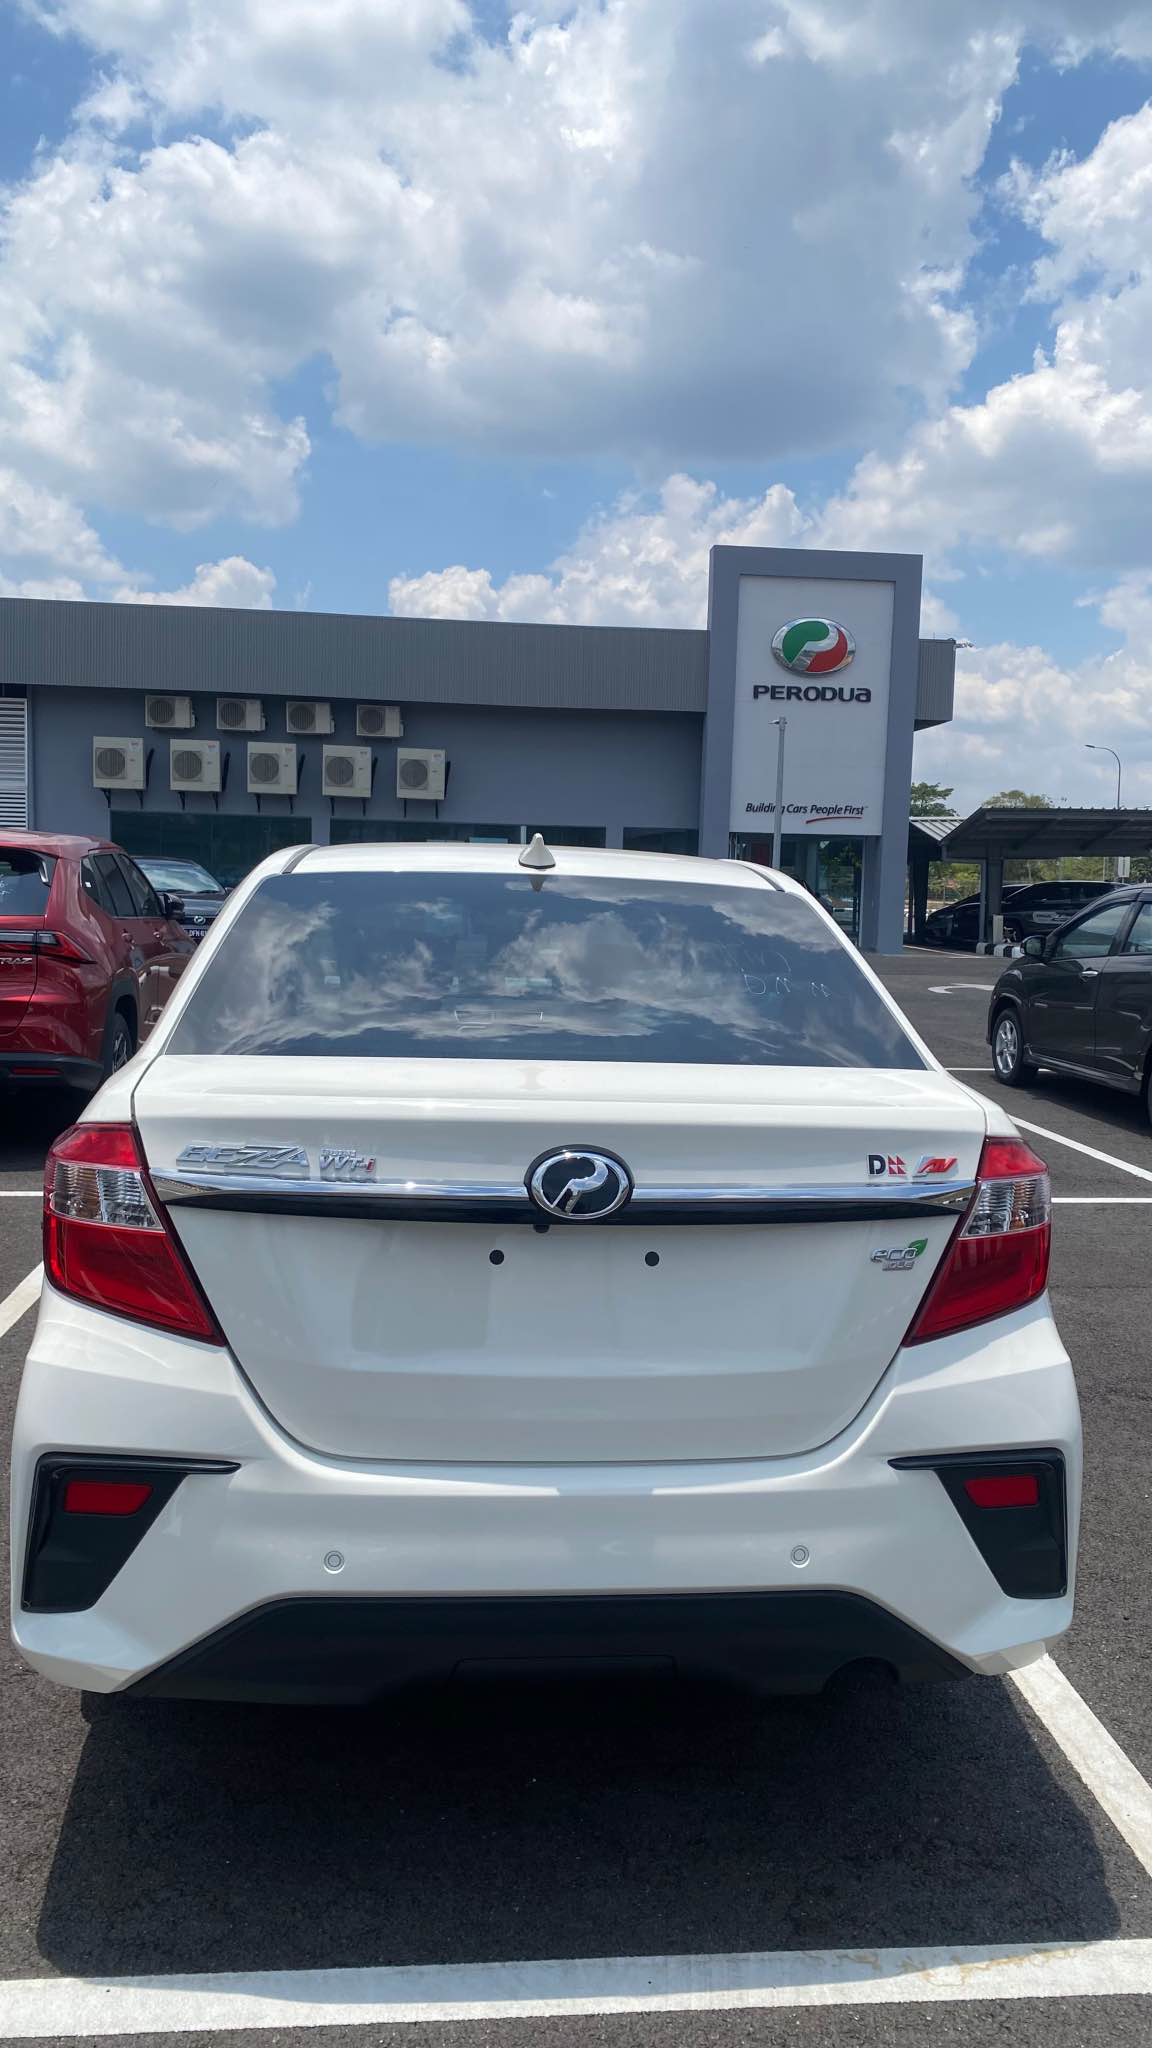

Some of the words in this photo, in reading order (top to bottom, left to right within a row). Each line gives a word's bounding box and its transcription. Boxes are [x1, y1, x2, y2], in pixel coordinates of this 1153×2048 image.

[786, 804, 808, 814] Cars
[810, 804, 844, 816] People
[844, 806, 864, 815] First
[176, 1145, 310, 1170] BEZZA
